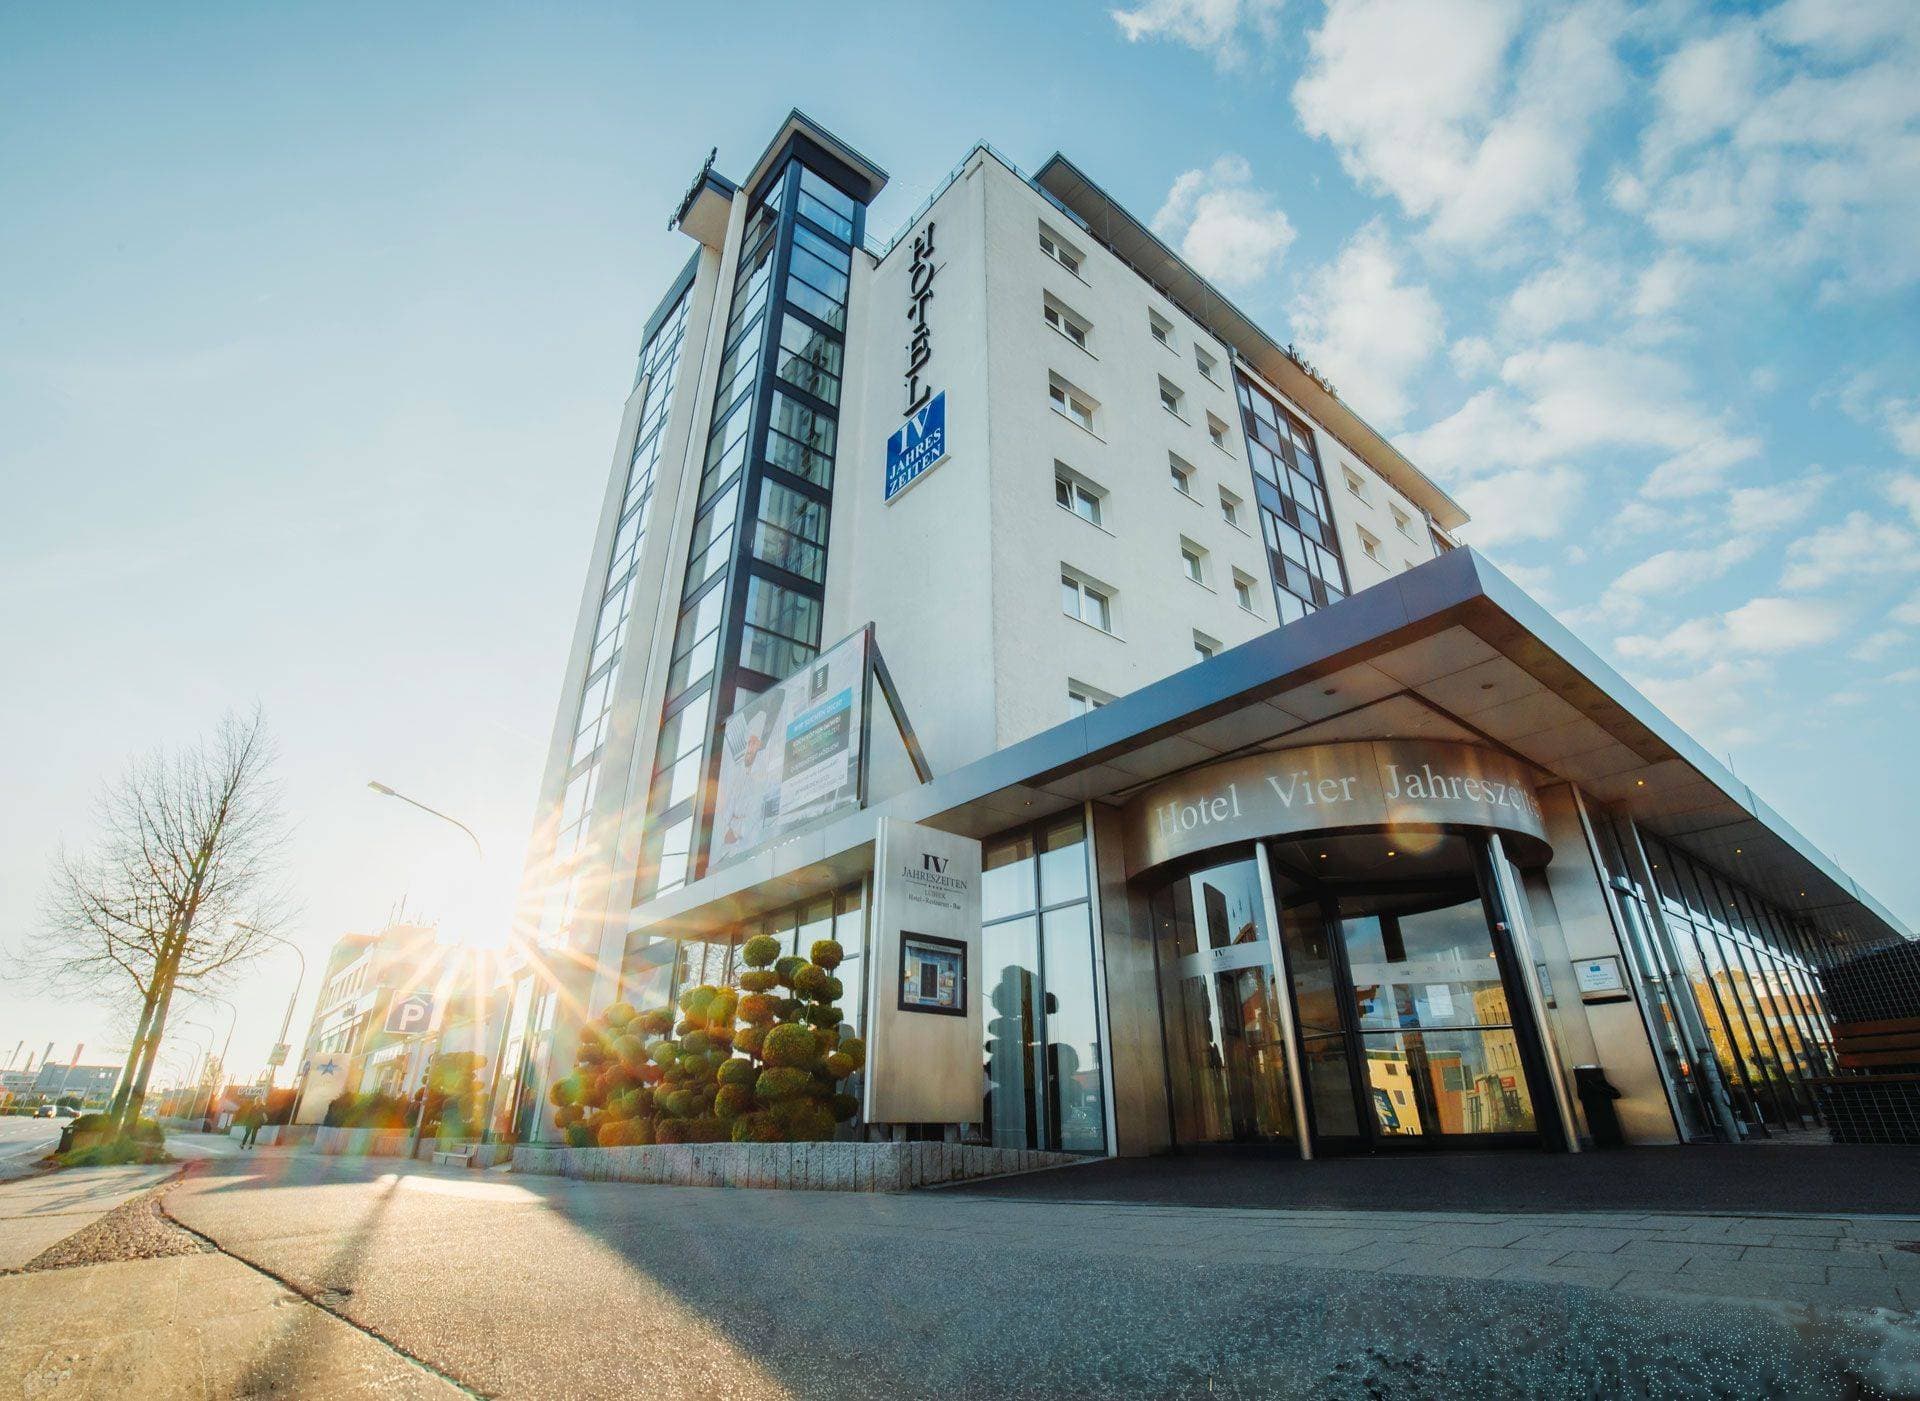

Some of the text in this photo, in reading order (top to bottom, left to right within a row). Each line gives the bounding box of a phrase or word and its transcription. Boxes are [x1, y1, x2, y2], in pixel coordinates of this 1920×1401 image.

[902, 221, 936, 418] HOTEL
[889, 427, 942, 480] JAHRES
[898, 402, 932, 456] IV
[889, 443, 943, 497] ZEITEN
[1156, 784, 1243, 841] Hotel
[1266, 769, 1357, 809] Vier
[902, 866, 969, 890] JAHRESZEITEN
[921, 853, 949, 874] IV
[398, 1003, 425, 1031] P
